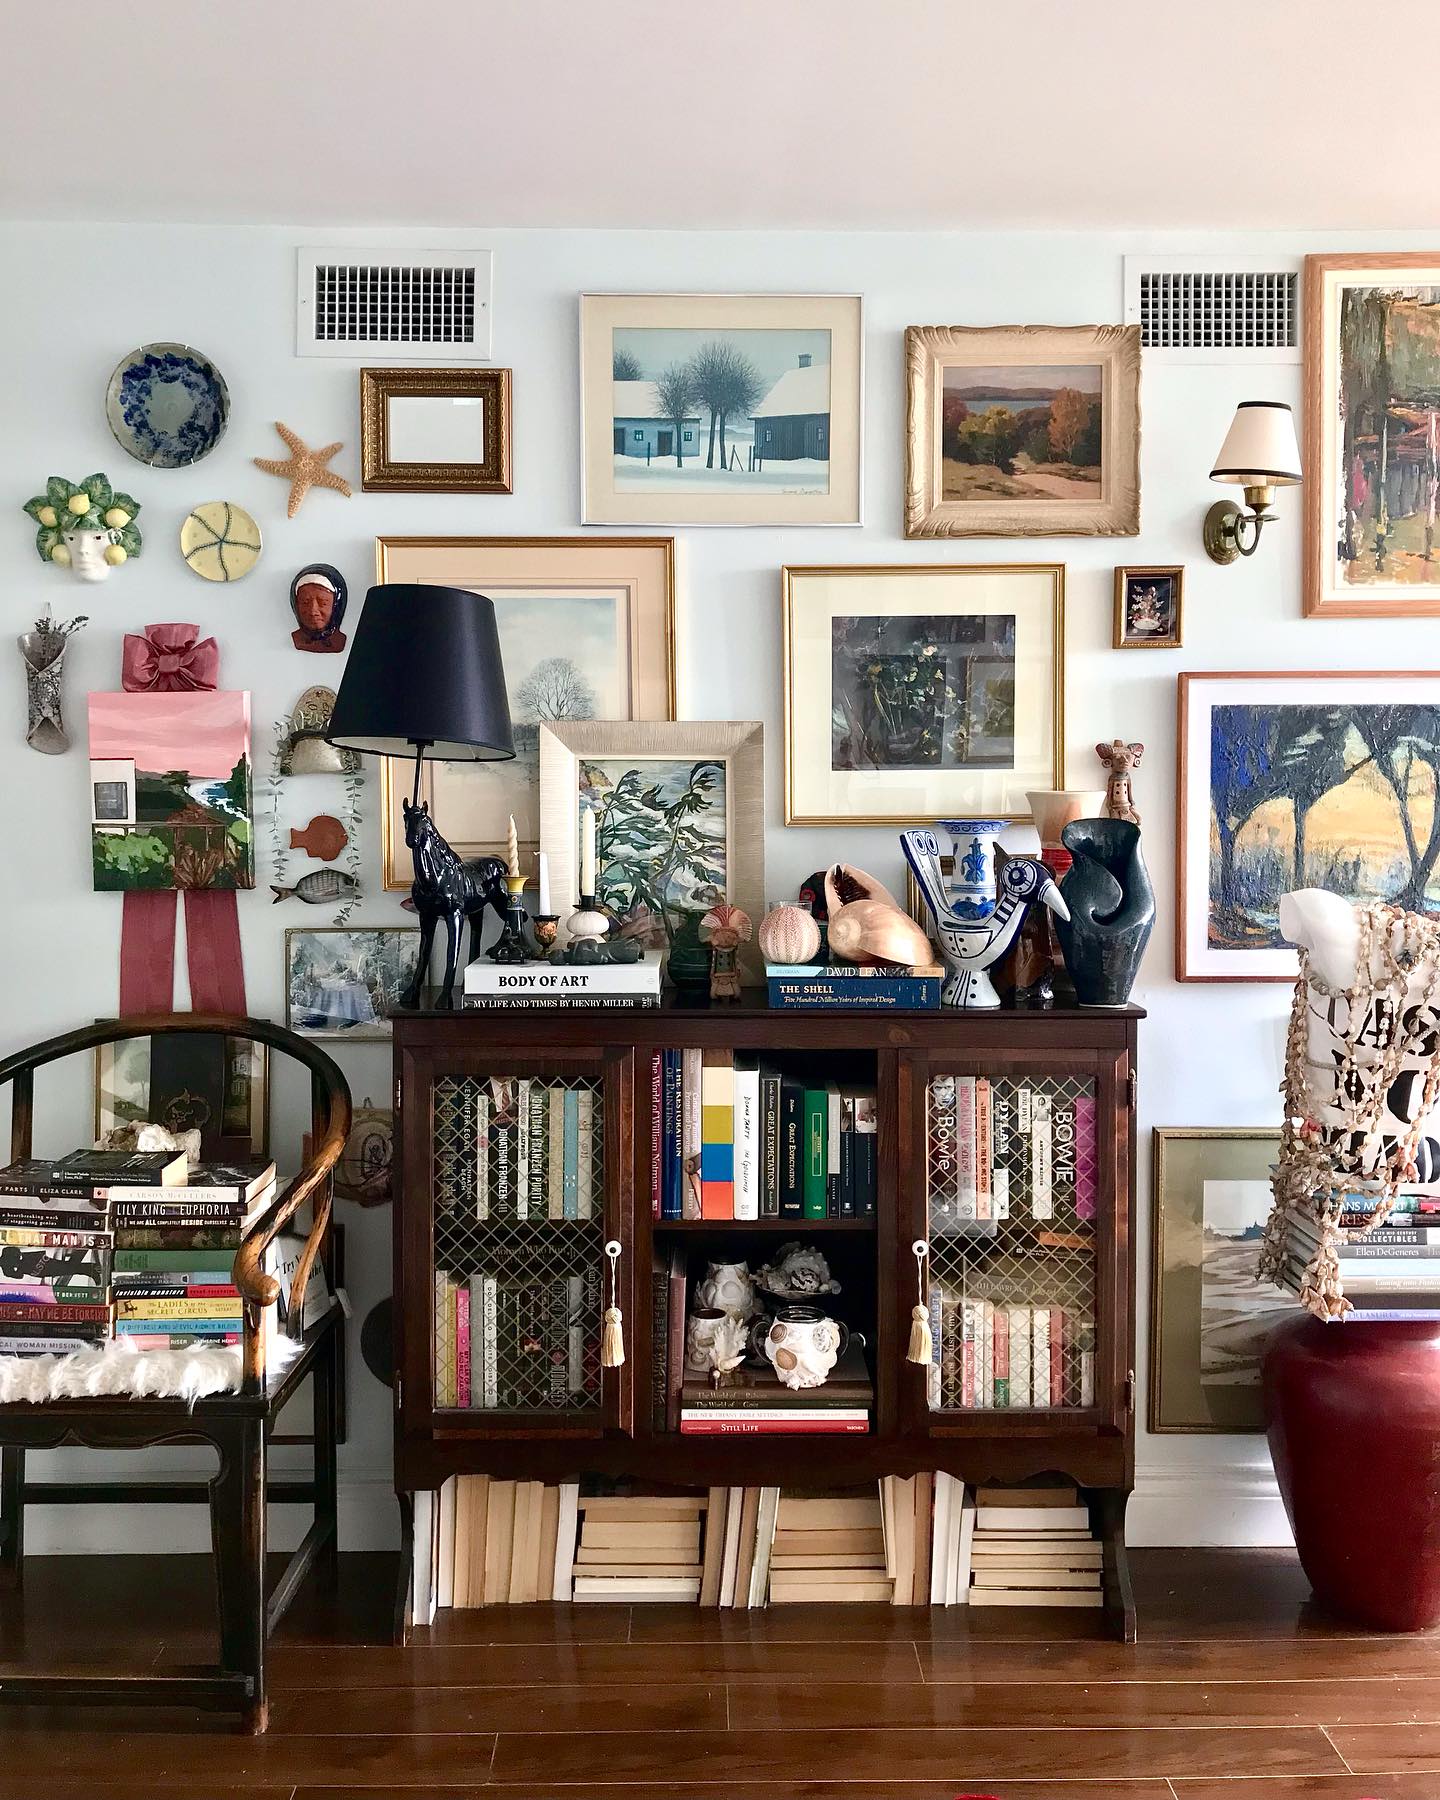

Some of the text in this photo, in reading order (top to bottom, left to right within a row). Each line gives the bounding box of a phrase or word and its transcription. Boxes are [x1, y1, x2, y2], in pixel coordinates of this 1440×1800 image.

[498, 976, 589, 987] BODY OF ART
[826, 967, 887, 977] DAVID LEAN
[780, 985, 835, 993] THE SHELL
[473, 1000, 488, 1008] MY
[489, 1000, 509, 1008] LIFE
[510, 1000, 529, 1008] AND
[530, 999, 558, 1007] TIMES
[559, 999, 571, 1007] BY
[572, 999, 601, 1007] HENRY
[602, 999, 634, 1007] MILLER
[652, 1055, 661, 1073] The
[652, 1075, 661, 1103] World
[666, 1067, 675, 1135] OF PAINTINGS
[767, 1111, 775, 1134] GREAT
[1000, 1100, 1009, 1155] DYLAN
[498, 1128, 507, 1164] JONATHAN
[938, 1116, 955, 1170] Bowie
[1056, 1111, 1073, 1182] BOWIE
[767, 1136, 775, 1190] EXPECTATIONS
[788, 1122, 797, 1189] GREAT EXPECTATIONS
[40, 1187, 60, 1195] ELIZA
[498, 1166, 507, 1200] FRANZEN
[531, 1177, 542, 1206] PURITY
[117, 1204, 231, 1216] LILY KING EUPHORIA
[52, 1234, 78, 1246] MAN
[83, 1235, 95, 1247] IS
[1356, 1248, 1419, 1256] Ellen DeGeneres
[721, 1423, 742, 1432] STILL
[742, 1423, 759, 1432] LIFE
